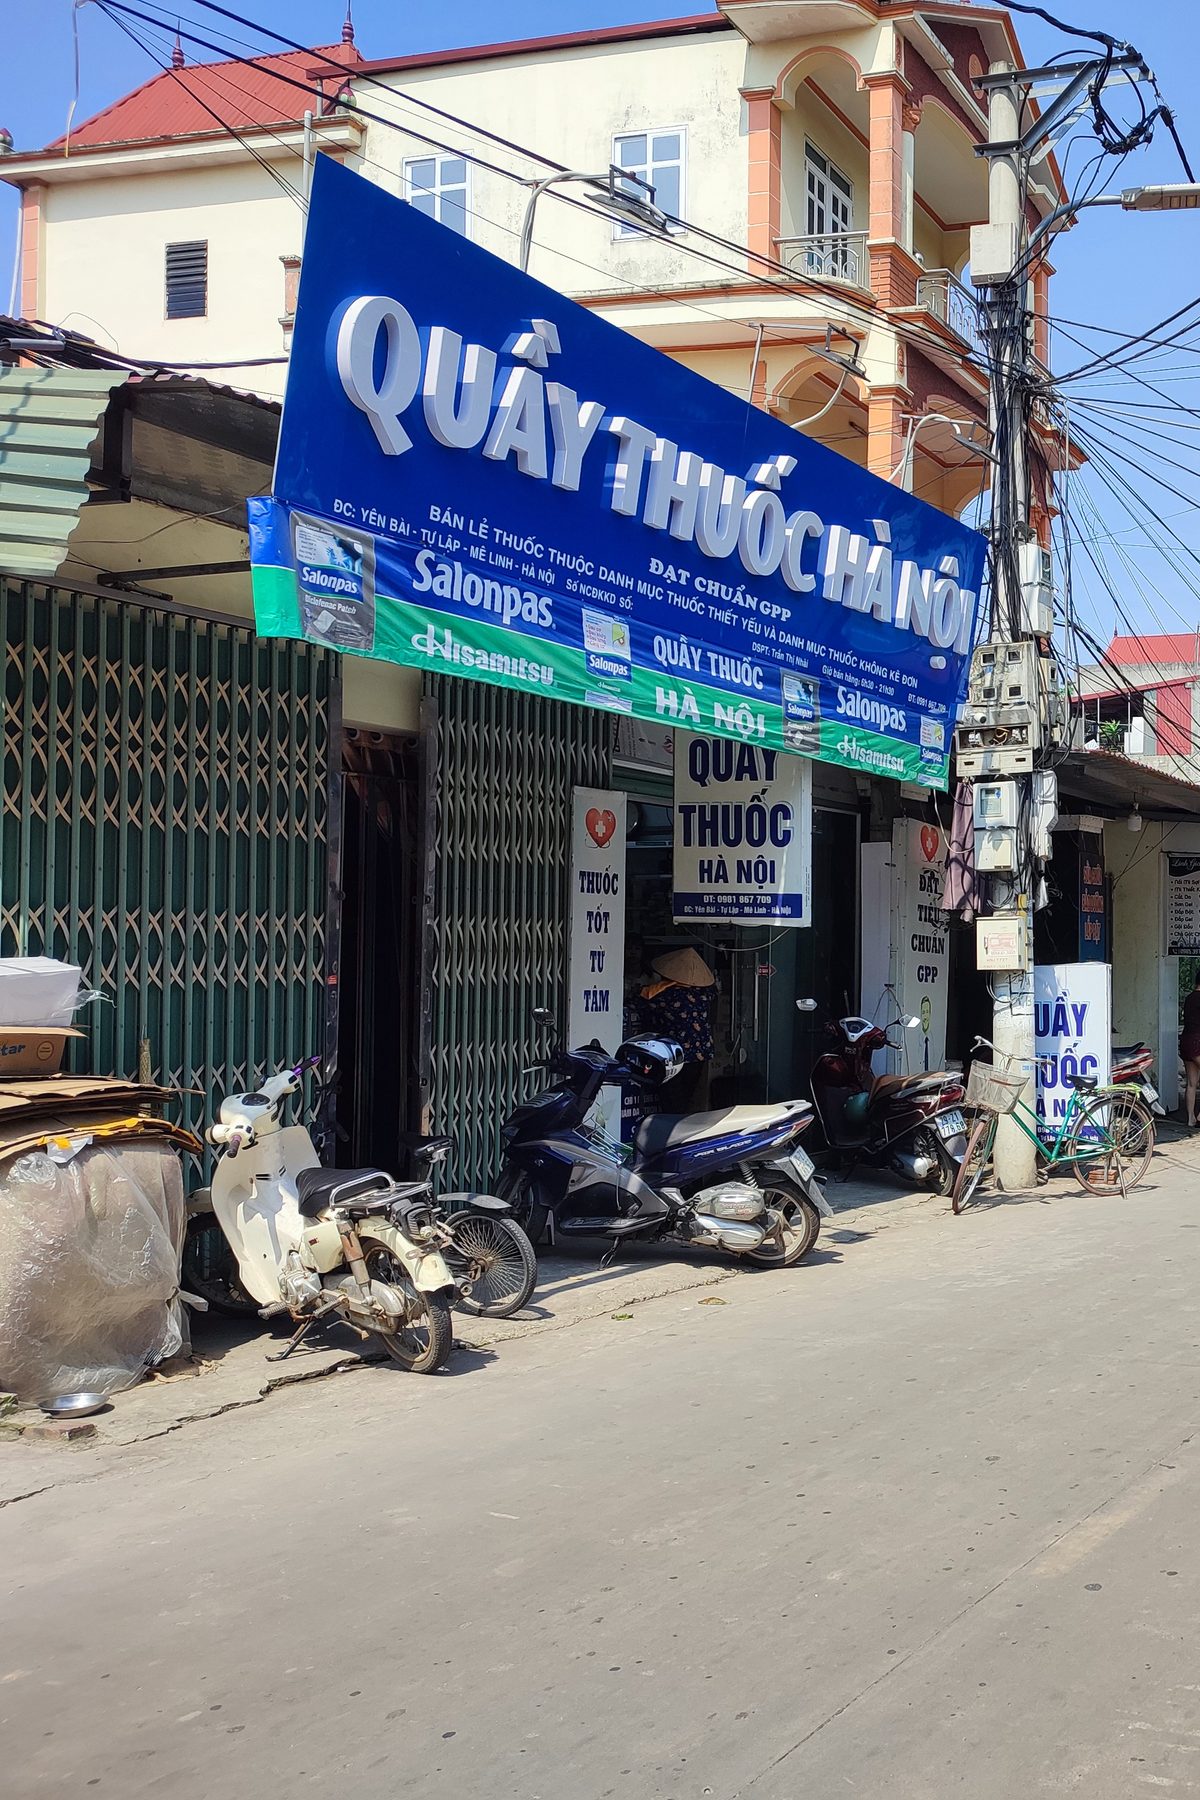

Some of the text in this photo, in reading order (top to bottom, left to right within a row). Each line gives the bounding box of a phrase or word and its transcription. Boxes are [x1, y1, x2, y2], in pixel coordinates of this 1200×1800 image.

[337, 295, 976, 669] QUẦY THUỐC HÀ NỘI
[333, 498, 356, 518] ĐC:
[360, 507, 386, 529] YÊN
[389, 517, 410, 537] BÀI
[420, 528, 437, 548] TỰ
[438, 534, 461, 556] LẬP
[469, 545, 486, 562] MÊ
[488, 551, 514, 570] LINH
[521, 562, 535, 579] HÀ
[538, 569, 556, 587] NỘI
[302, 566, 359, 594] Salonpas
[412, 549, 554, 629] Salonpas
[429, 505, 464, 531] BÁN
[468, 517, 489, 540] LẺ
[493, 527, 544, 559] THUỐC
[548, 547, 595, 577] THUỘC
[598, 565, 634, 590] DANH
[637, 579, 664, 601] MỤC
[666, 590, 705, 615] THUỐC
[708, 605, 738, 627] THIẾT
[741, 616, 762, 635] YẾU
[764, 625, 777, 641] VÀ
[778, 631, 804, 650] DANH
[806, 640, 826, 659] MỤC
[828, 648, 858, 668] THUỐC
[859, 657, 888, 679] KHÔNG
[901, 674, 918, 689] ĐƠN
[649, 557, 792, 622] ĐẠT CHUẨN GPP
[410, 624, 556, 686] Hisamitsu
[589, 654, 628, 677] Salonpas
[653, 634, 702, 672] QUẦY
[707, 651, 764, 690] THUỐC
[655, 686, 701, 723] HÀ
[713, 702, 766, 739] NỘI
[787, 702, 813, 719] Salonpas
[836, 685, 907, 733] Salonpas
[836, 734, 905, 772] Hisamitsu
[678, 787, 793, 848] THUỐC
[579, 864, 619, 896] THUỐC
[698, 854, 776, 890] HÀ NỘI
[586, 903, 610, 934] TỐT
[911, 929, 945, 955] CHUẨN
[917, 964, 938, 983] GPP
[583, 985, 610, 1013] TÂM
[1034, 991, 1088, 1037] UẦY
[0, 1043, 26, 1056] tar
[1036, 1043, 1098, 1089] UỐC
[1036, 1094, 1047, 1117] À
